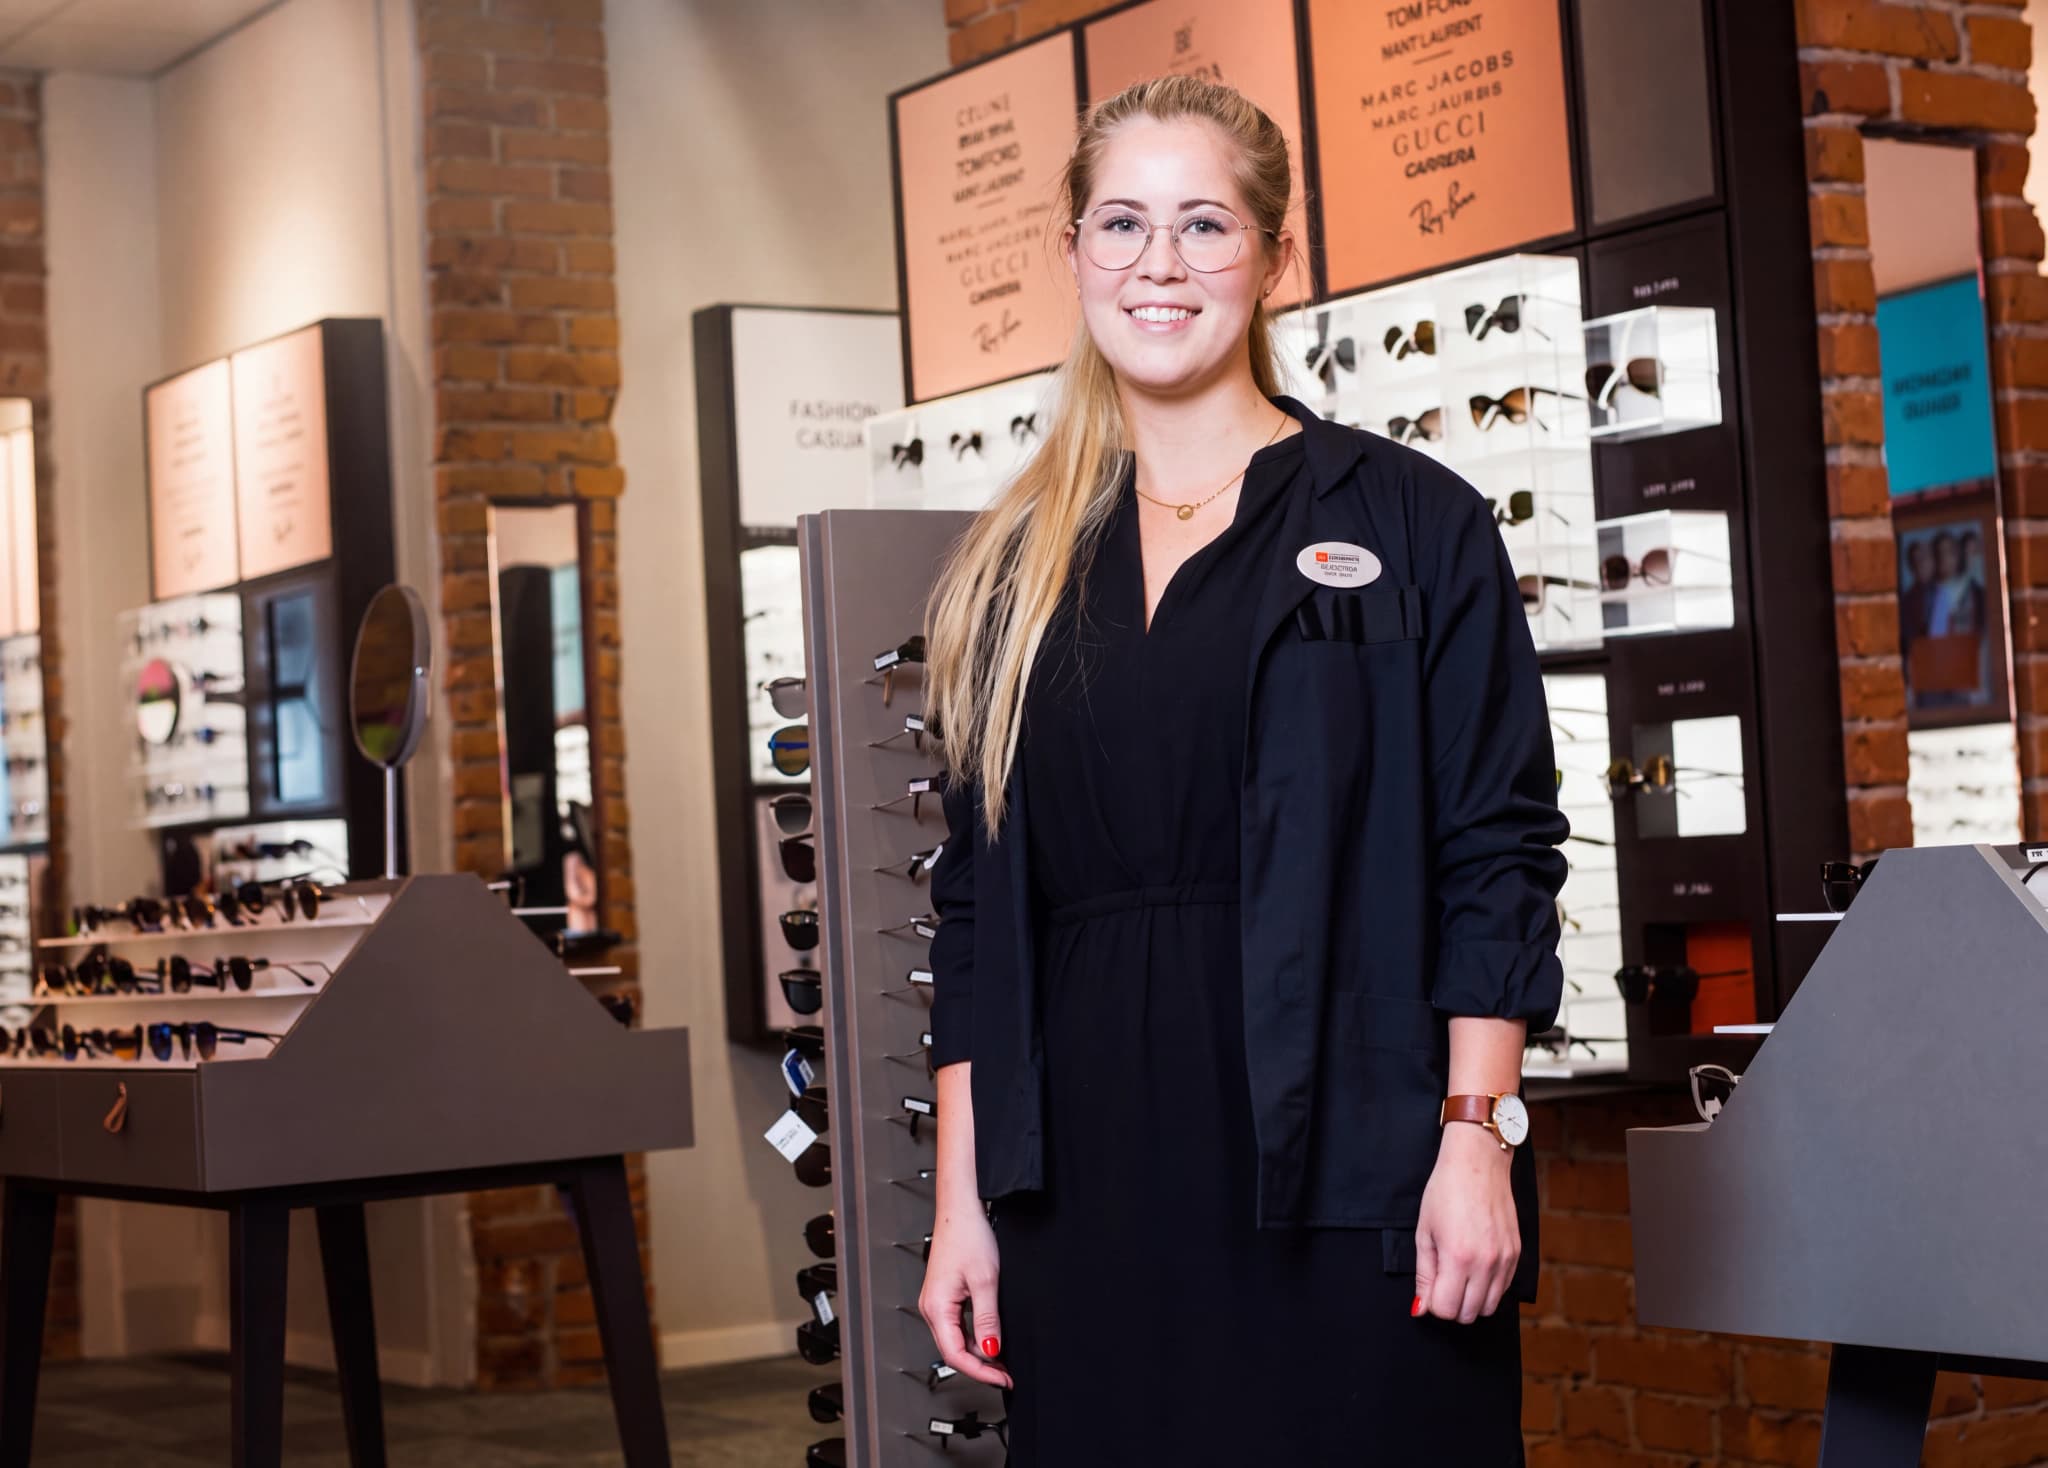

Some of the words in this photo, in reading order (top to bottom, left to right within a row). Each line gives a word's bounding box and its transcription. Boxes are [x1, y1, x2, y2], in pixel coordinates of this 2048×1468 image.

[1386, 1, 1422, 30] TOM
[1419, 13, 1482, 49] LAURENT
[1360, 80, 1417, 109] MARC
[1426, 49, 1514, 92] JACOBS
[1371, 105, 1420, 130] MARC
[1392, 110, 1485, 158] GUCCI
[1405, 146, 1476, 179] CARRERA
